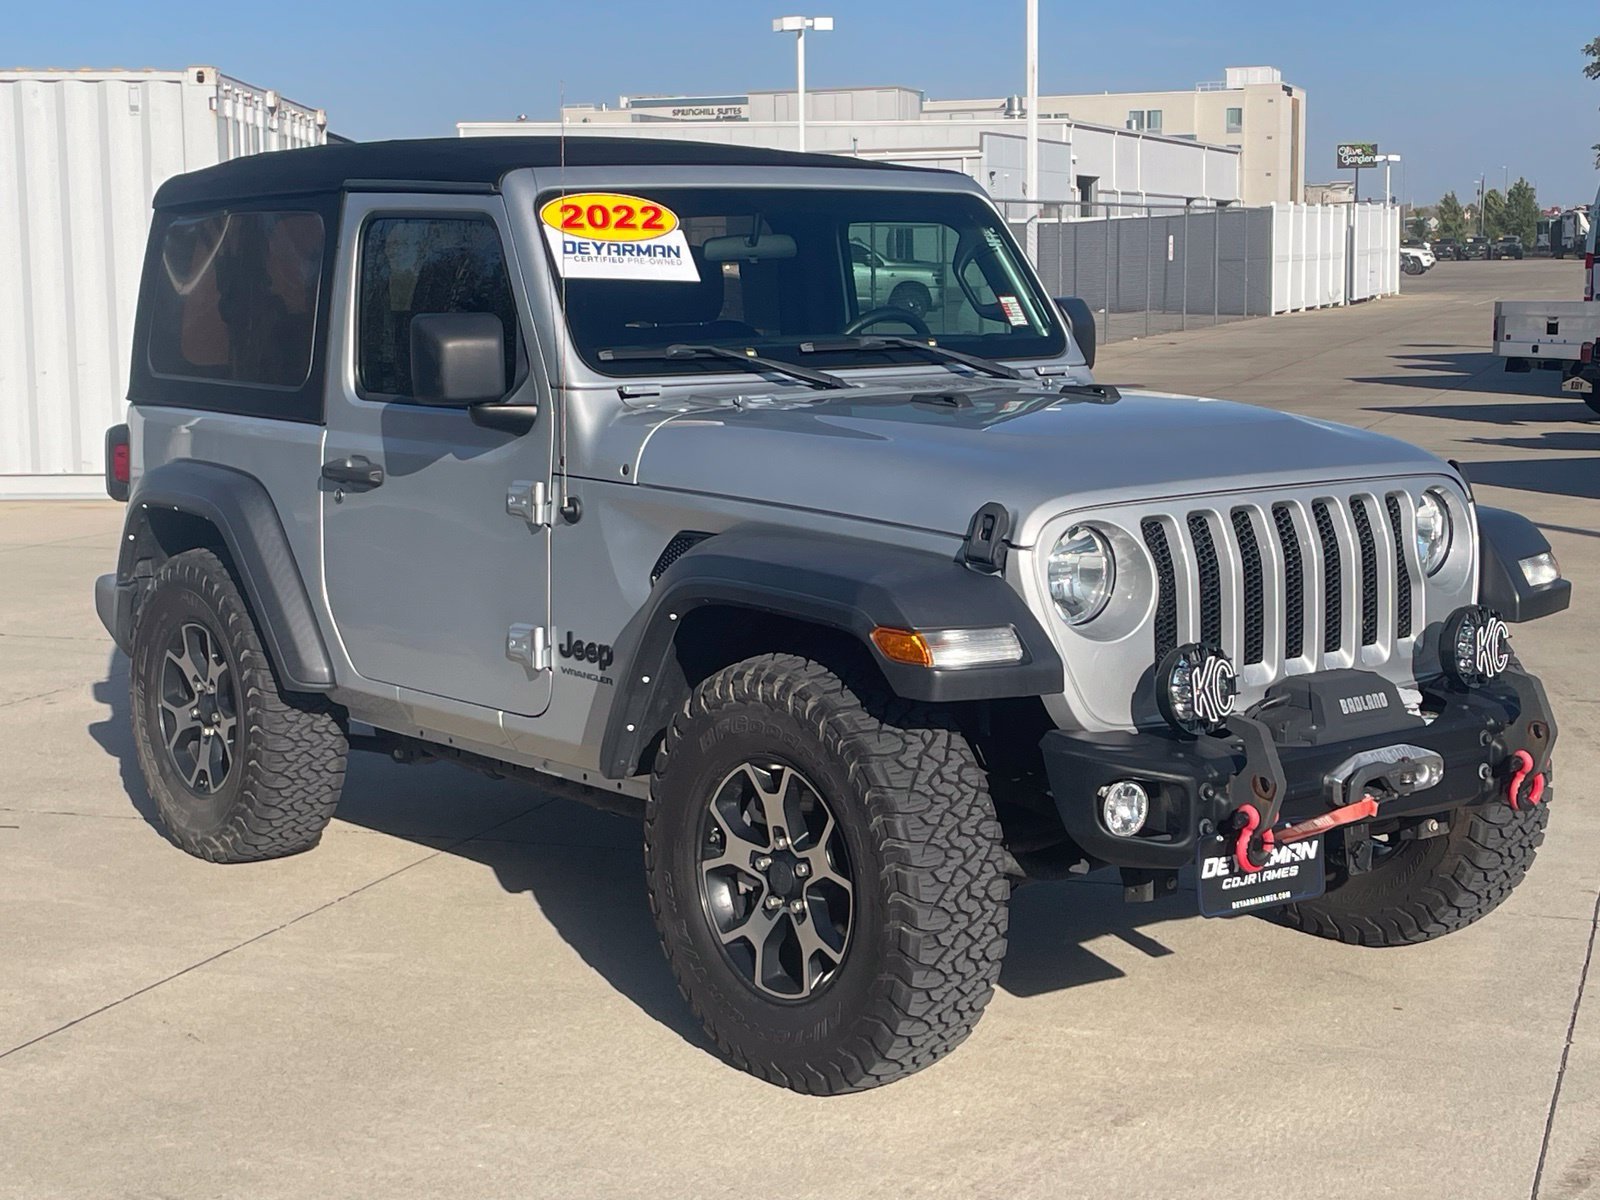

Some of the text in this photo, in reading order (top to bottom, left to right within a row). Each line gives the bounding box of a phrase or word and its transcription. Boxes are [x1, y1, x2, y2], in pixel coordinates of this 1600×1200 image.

[672, 107, 742, 117] SPRINGHILL SUITES
[1338, 145, 1362, 156] Olive
[1341, 154, 1376, 165] Garden
[560, 204, 665, 231] 2022
[563, 240, 681, 259] DEYARMAN
[573, 255, 683, 266] CERTIFIED PRE-OWNED
[559, 631, 613, 671] Jeep
[1476, 617, 1509, 677] KC
[561, 666, 613, 686] WRANGLER
[1192, 656, 1236, 722] KC
[1339, 692, 1389, 714] BADLAND
[1201, 840, 1318, 879] DEMAN
[1221, 865, 1299, 890] CDJR AMES
